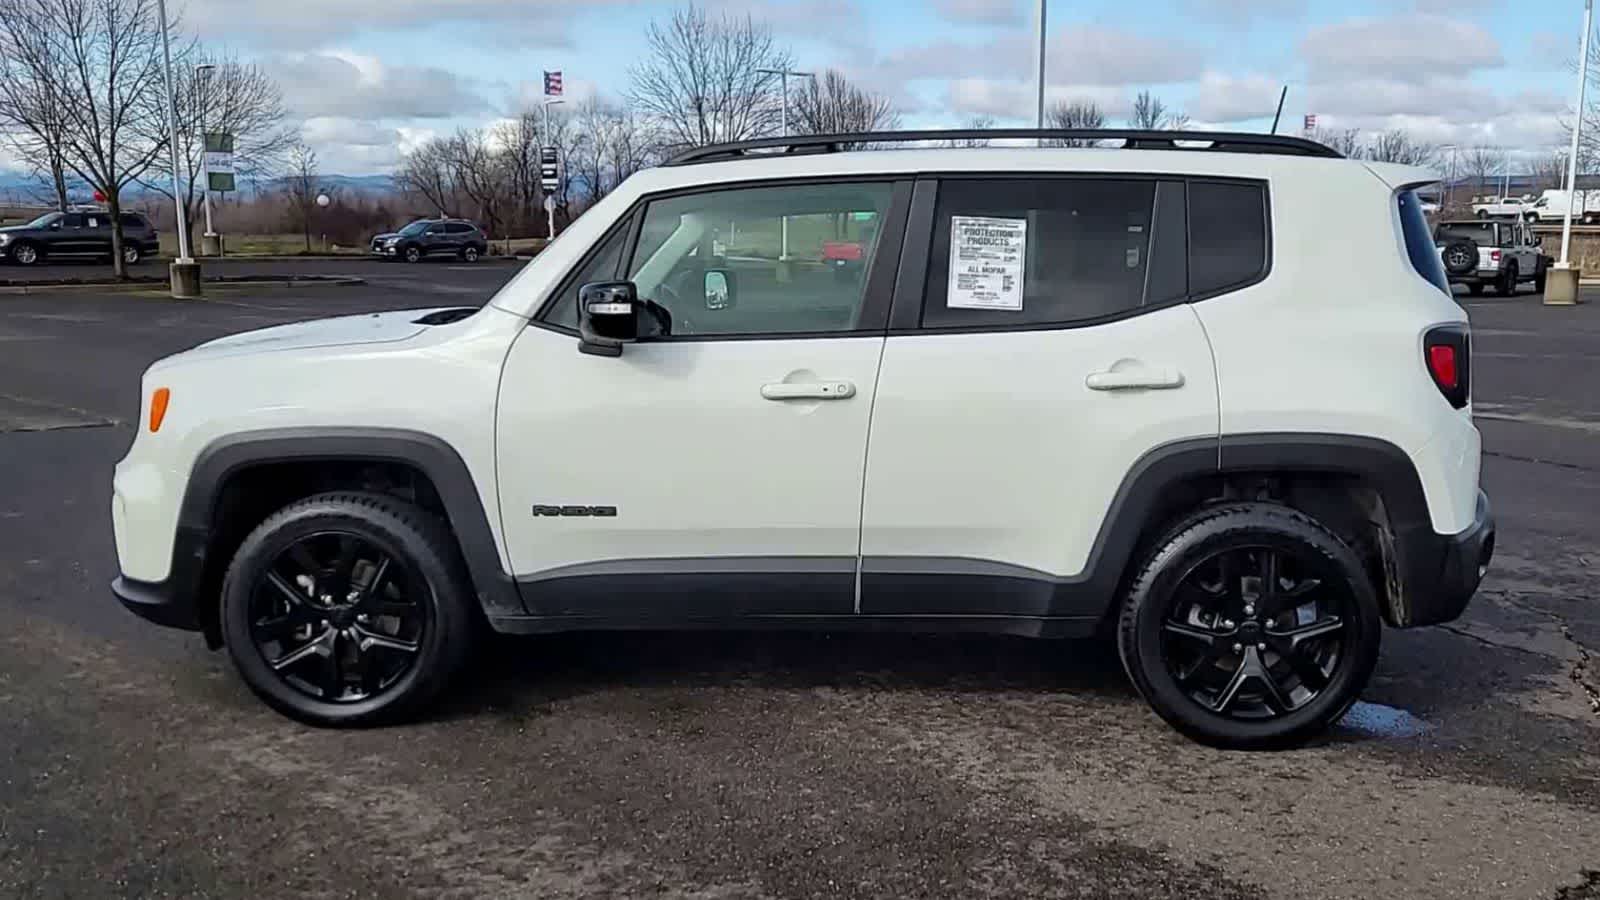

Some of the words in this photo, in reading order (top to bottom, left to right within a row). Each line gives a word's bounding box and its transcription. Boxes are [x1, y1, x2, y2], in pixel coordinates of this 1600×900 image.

[964, 228, 1014, 237] PROTECTION
[967, 237, 1010, 246] PRODUCTS
[982, 266, 1006, 274] MOPAR
